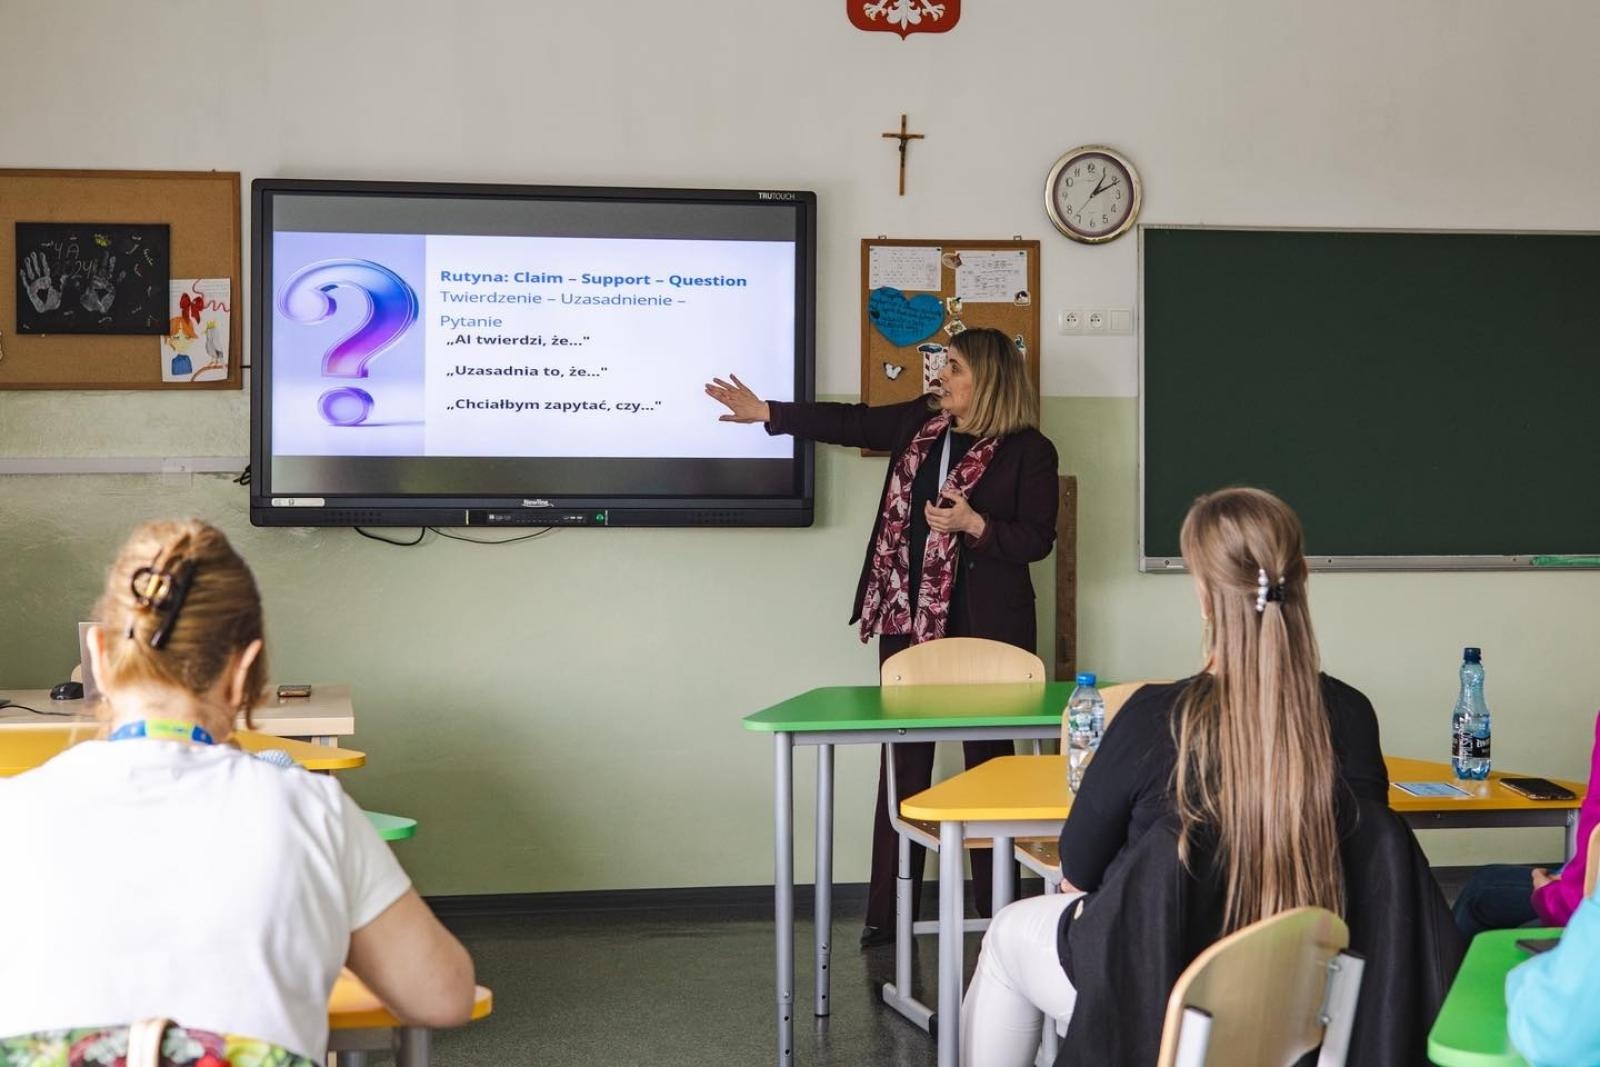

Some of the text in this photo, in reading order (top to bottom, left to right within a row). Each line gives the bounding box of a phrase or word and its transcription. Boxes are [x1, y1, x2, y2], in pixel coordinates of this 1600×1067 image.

[440, 270, 509, 286] Rutyna:
[514, 271, 564, 284] Claim
[581, 273, 651, 288] Support
[669, 274, 748, 288] Question
[440, 290, 543, 304] Twierdzenie
[561, 293, 673, 306] Uzasadnienie
[440, 315, 503, 330] Pytanie
[476, 335, 547, 347] twierdzi,
[446, 365, 539, 377] „Uzasadnia
[543, 367, 565, 378] to,
[446, 398, 540, 412] „Chciałbym
[544, 399, 611, 413] zapytać,
